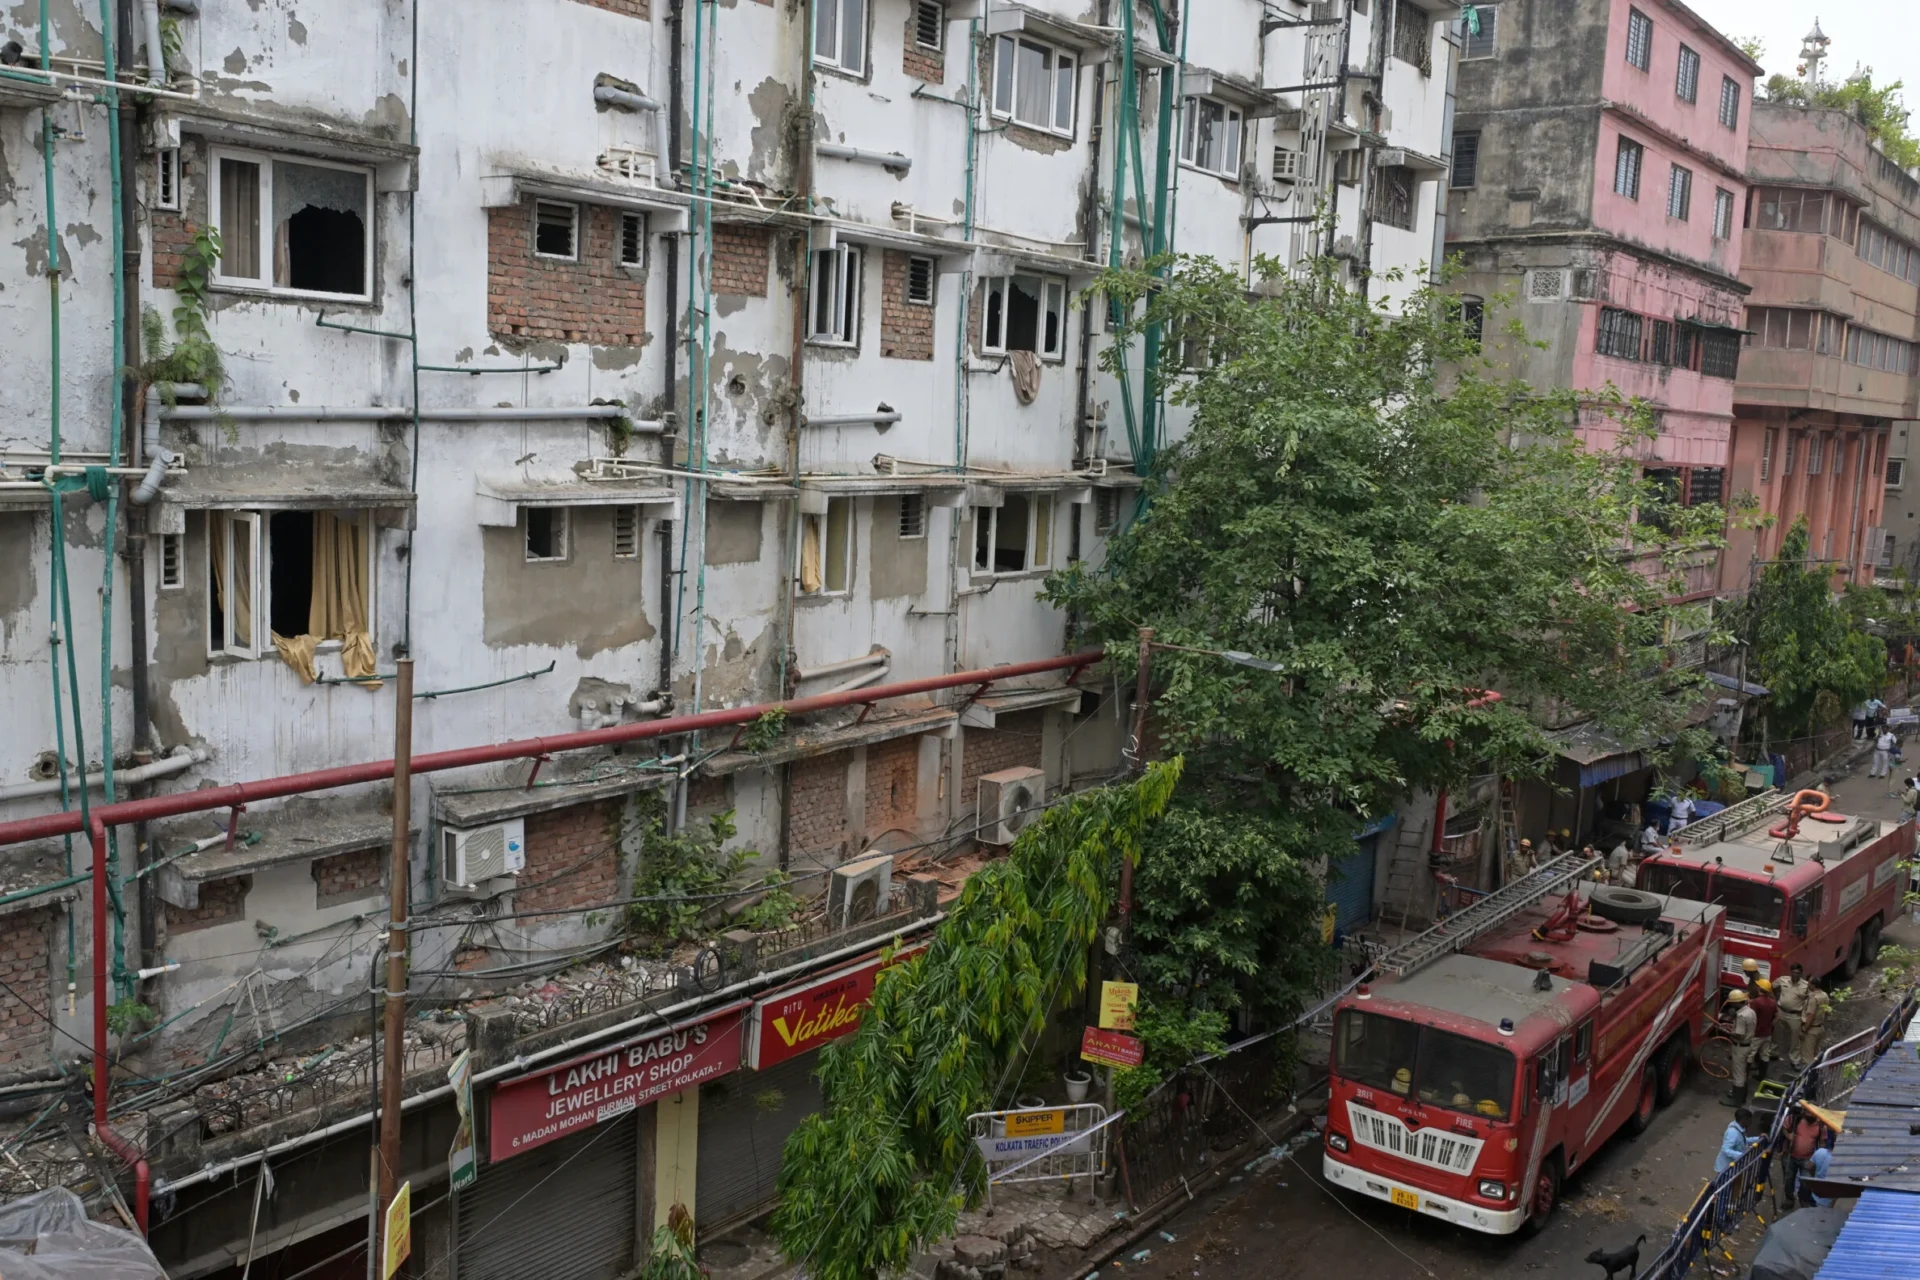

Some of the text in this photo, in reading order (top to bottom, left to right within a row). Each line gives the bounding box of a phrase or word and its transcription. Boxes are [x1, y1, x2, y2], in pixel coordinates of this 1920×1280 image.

[783, 1000, 803, 1016] RITU
[772, 994, 859, 1047] Vatika
[1086, 1038, 1121, 1052] ARATI
[548, 1056, 619, 1096] LAKHI
[545, 1053, 693, 1119] JEWELLERY SHOP
[522, 1122, 558, 1144] MADAN
[559, 1109, 594, 1130] MOHAN
[597, 1093, 636, 1115] BURMAN
[638, 1080, 672, 1100] STREET
[675, 1061, 723, 1087] KOLKATA-7
[1015, 1113, 1054, 1125] SKIPPER
[1455, 1116, 1473, 1129] FIRE
[995, 1139, 1022, 1152] KOLKATA
[1024, 1138, 1049, 1150] TRAFFIC
[453, 1170, 473, 1192] Ward
